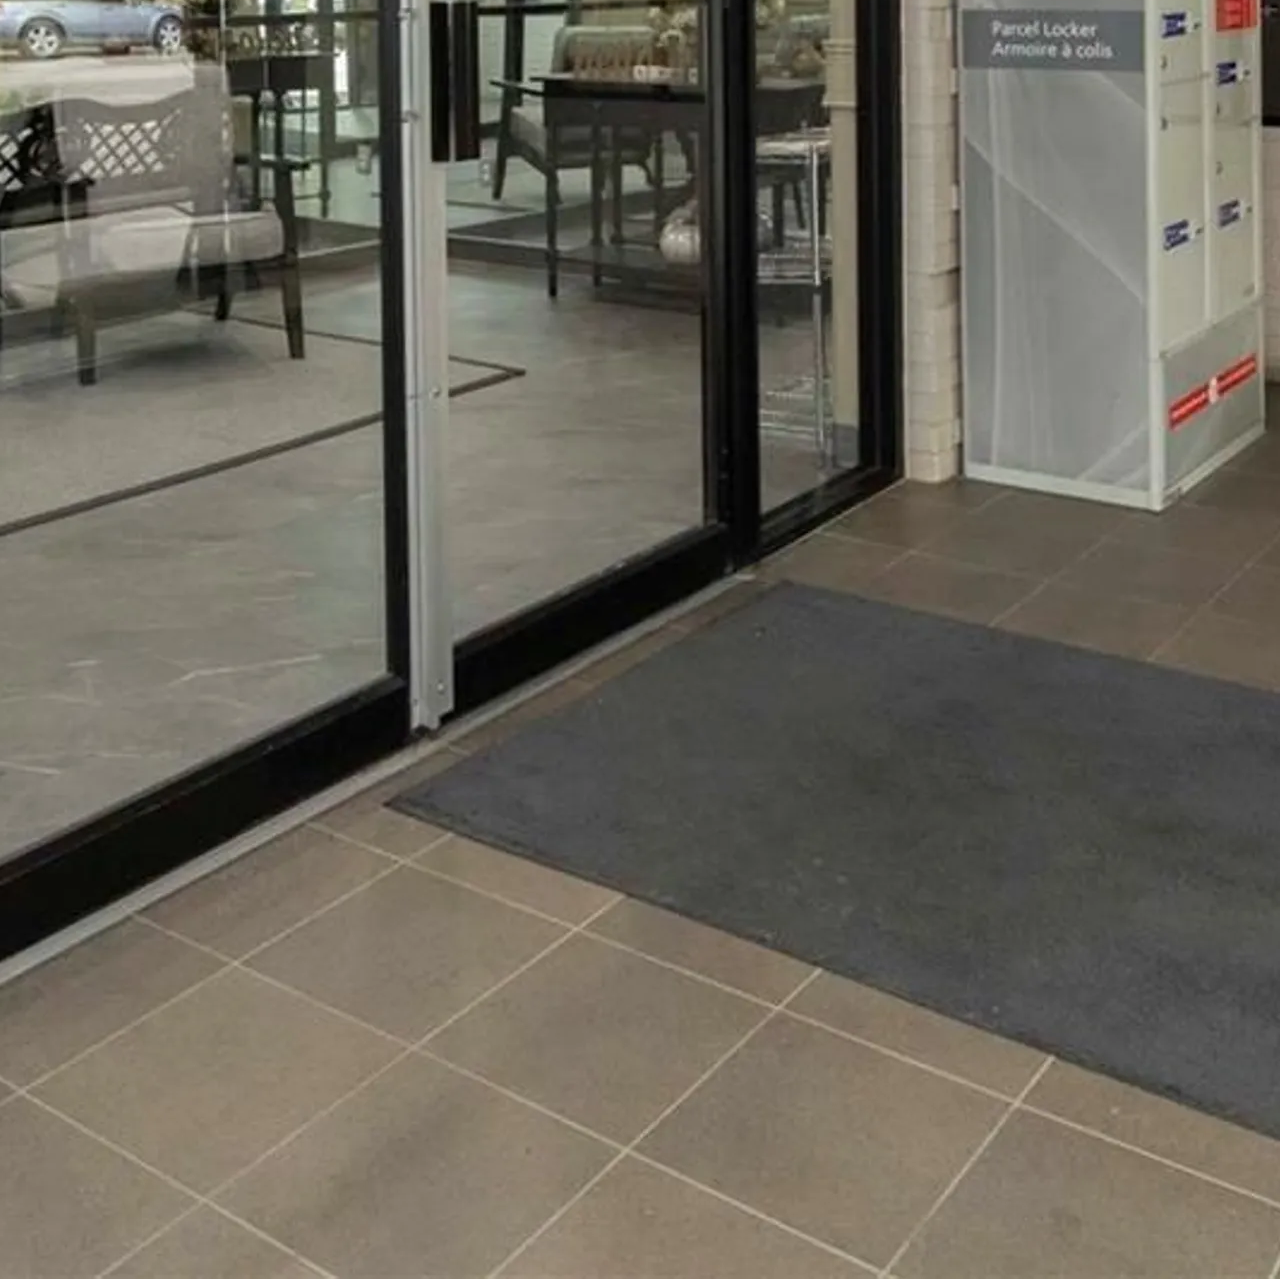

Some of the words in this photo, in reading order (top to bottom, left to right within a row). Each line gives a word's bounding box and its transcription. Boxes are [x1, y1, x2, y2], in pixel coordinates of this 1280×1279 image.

[991, 20, 1040, 38] Parcel
[1043, 21, 1098, 38] Locker
[991, 41, 1057, 59] Armoire
[1075, 42, 1114, 59] colis
